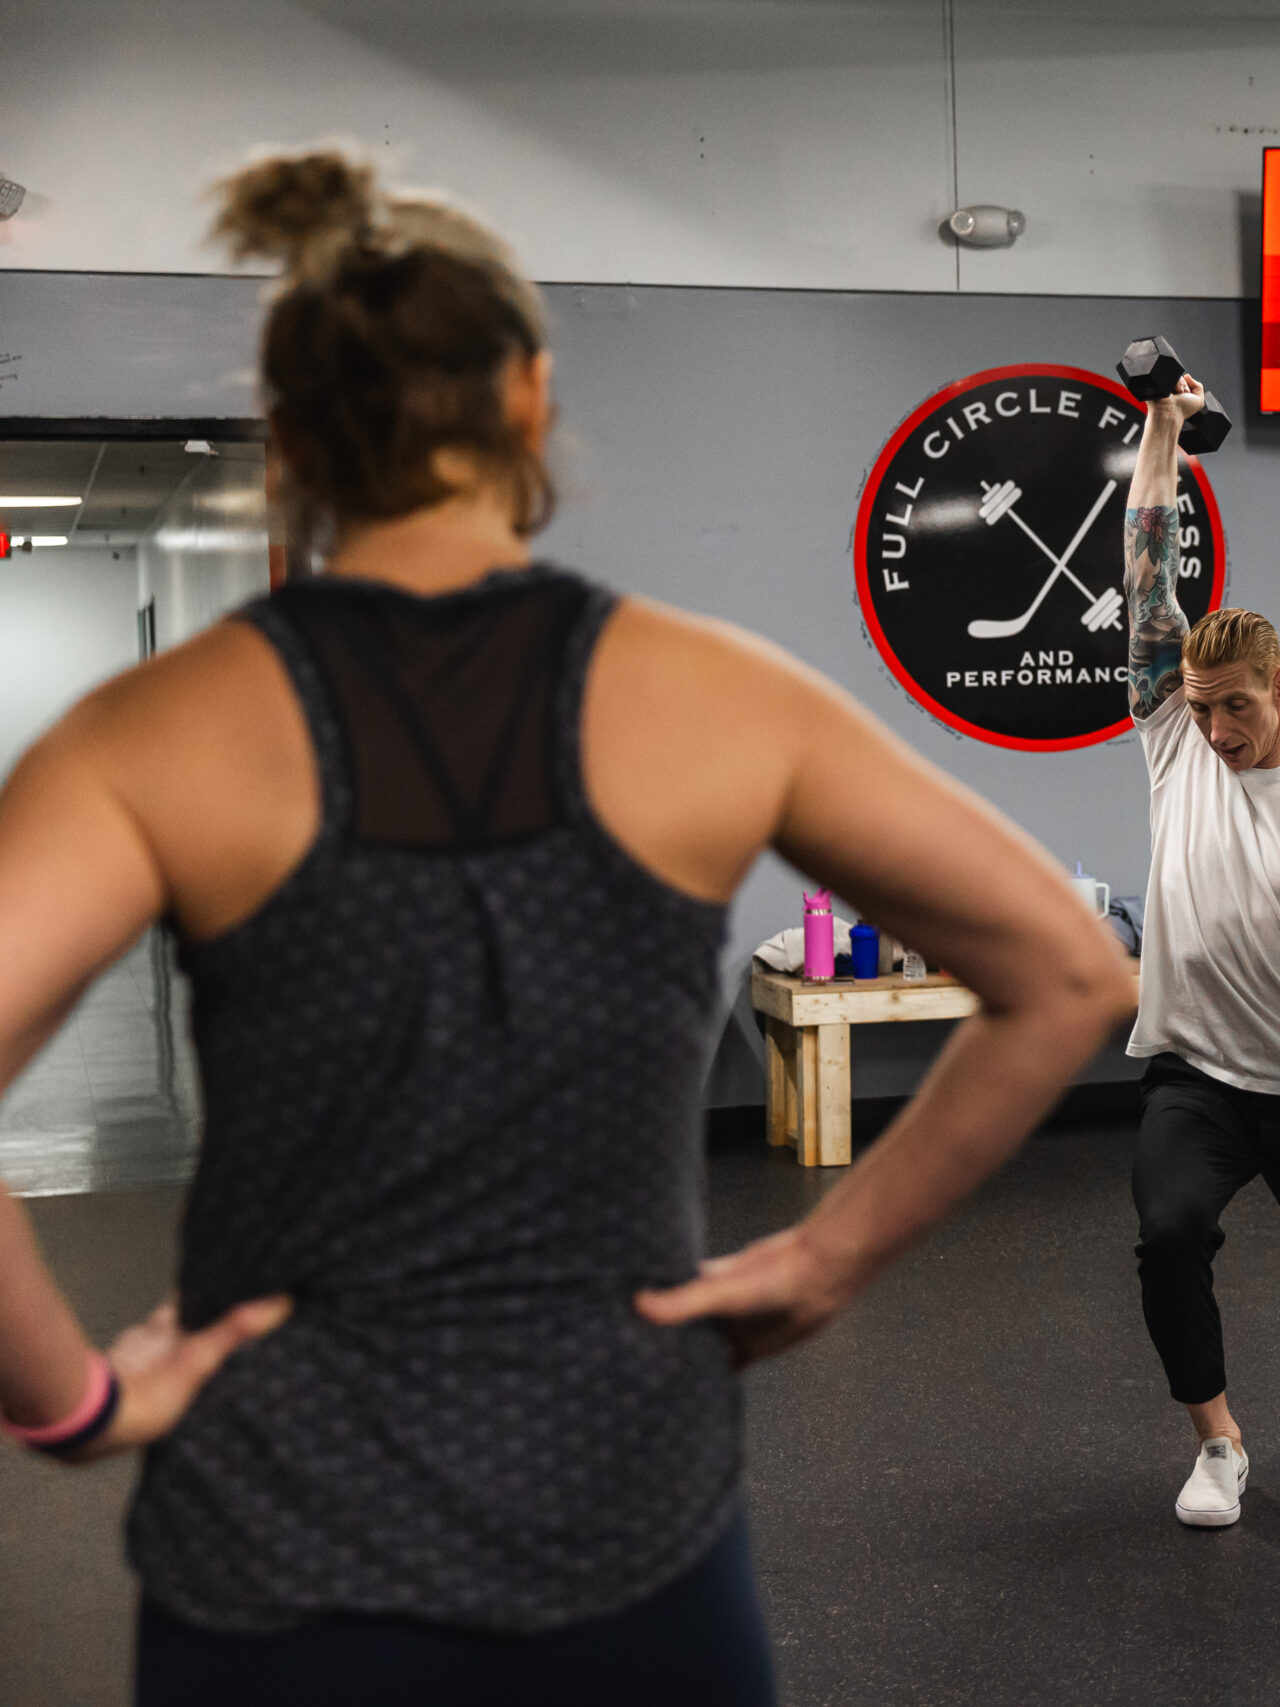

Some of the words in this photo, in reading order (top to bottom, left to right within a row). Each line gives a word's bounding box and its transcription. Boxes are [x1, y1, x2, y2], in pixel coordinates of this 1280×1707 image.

[882, 476, 925, 592] FULL
[923, 388, 1082, 459] CIRCLE
[1098, 405, 1201, 579] FIESS
[1019, 650, 1074, 667] AND
[946, 666, 1129, 688] PERFORMANC
